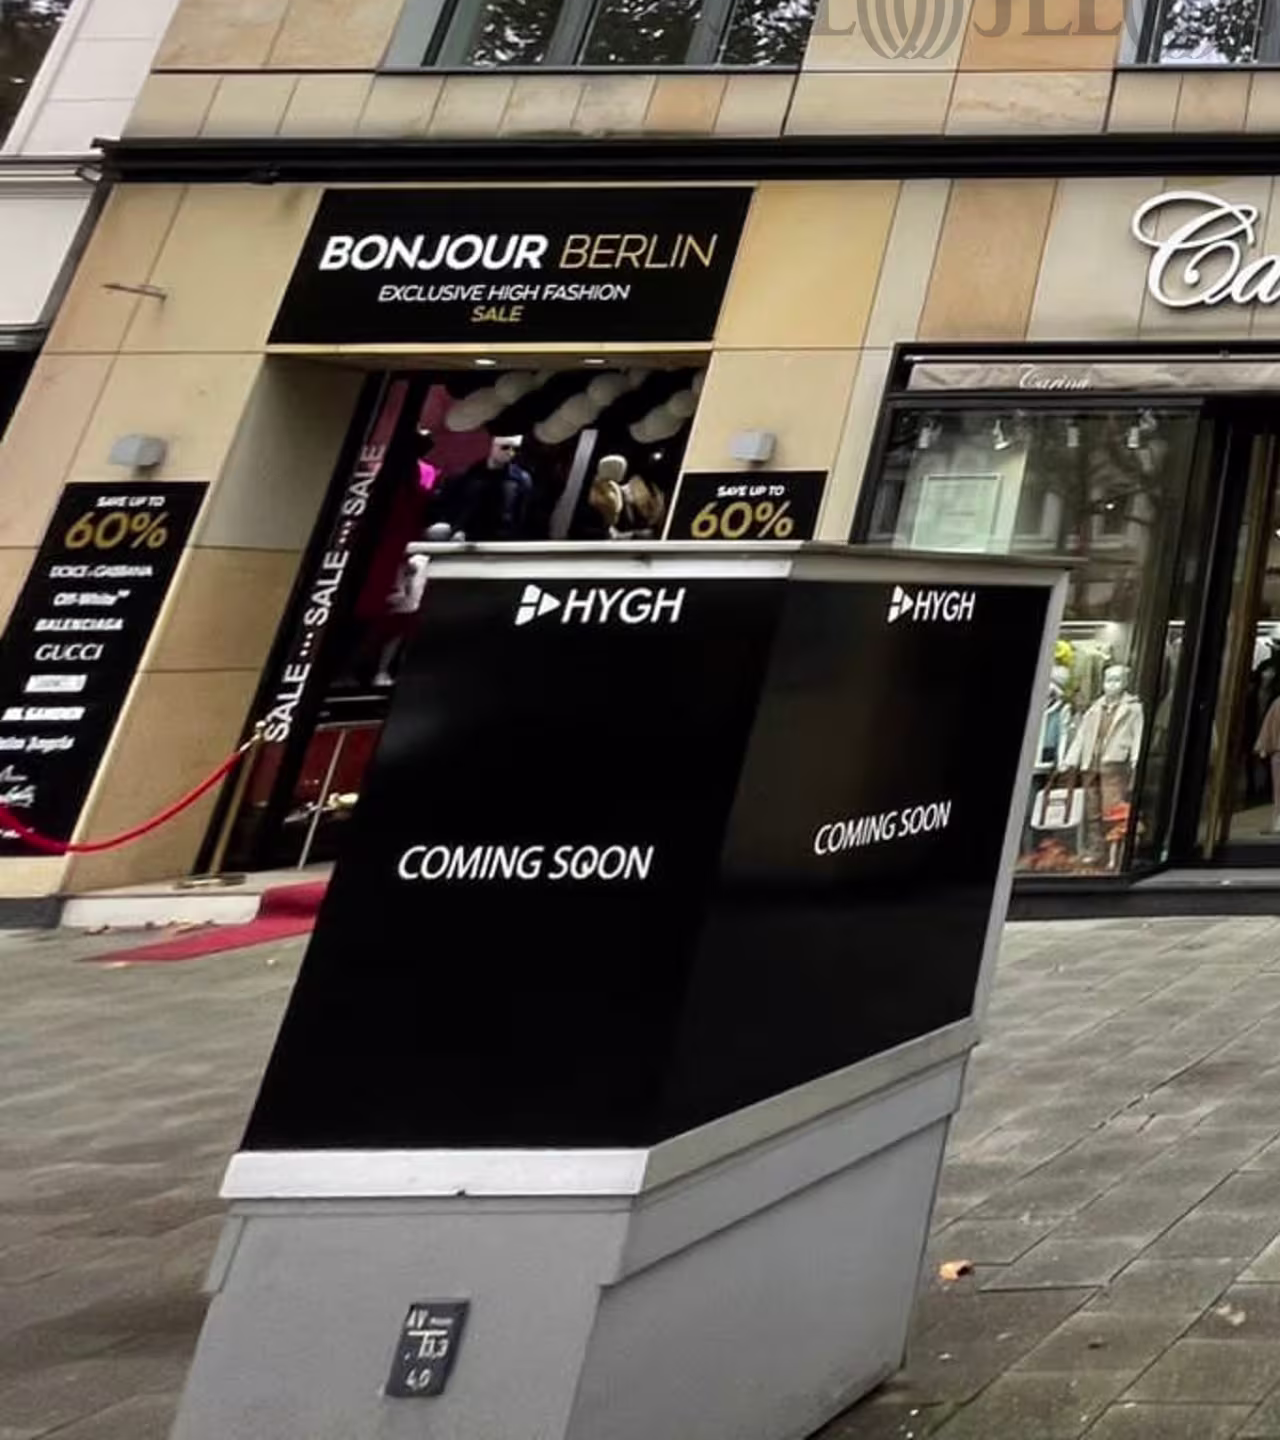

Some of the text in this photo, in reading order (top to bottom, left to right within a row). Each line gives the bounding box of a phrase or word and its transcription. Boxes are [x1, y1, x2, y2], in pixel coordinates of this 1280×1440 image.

[318, 234, 718, 270] BONJOUR BERLIN
[378, 285, 631, 302] EXCLUSIVE HIGH FASHION
[470, 305, 525, 322] SALE
[1020, 363, 1090, 390] Carina
[341, 444, 386, 516] SALE
[717, 485, 785, 497] SAVE UP TO
[127, 496, 147, 507] UP
[149, 496, 165, 507] TO
[64, 512, 169, 549] 60%
[690, 500, 795, 538] 60%
[303, 550, 350, 627] SALE
[561, 588, 685, 623] HYGH
[912, 591, 976, 622] HYGH
[34, 644, 104, 661] GUCCI
[264, 662, 312, 743] SALE
[813, 800, 952, 855] COMING SOON
[398, 846, 654, 880] COMING SOON
